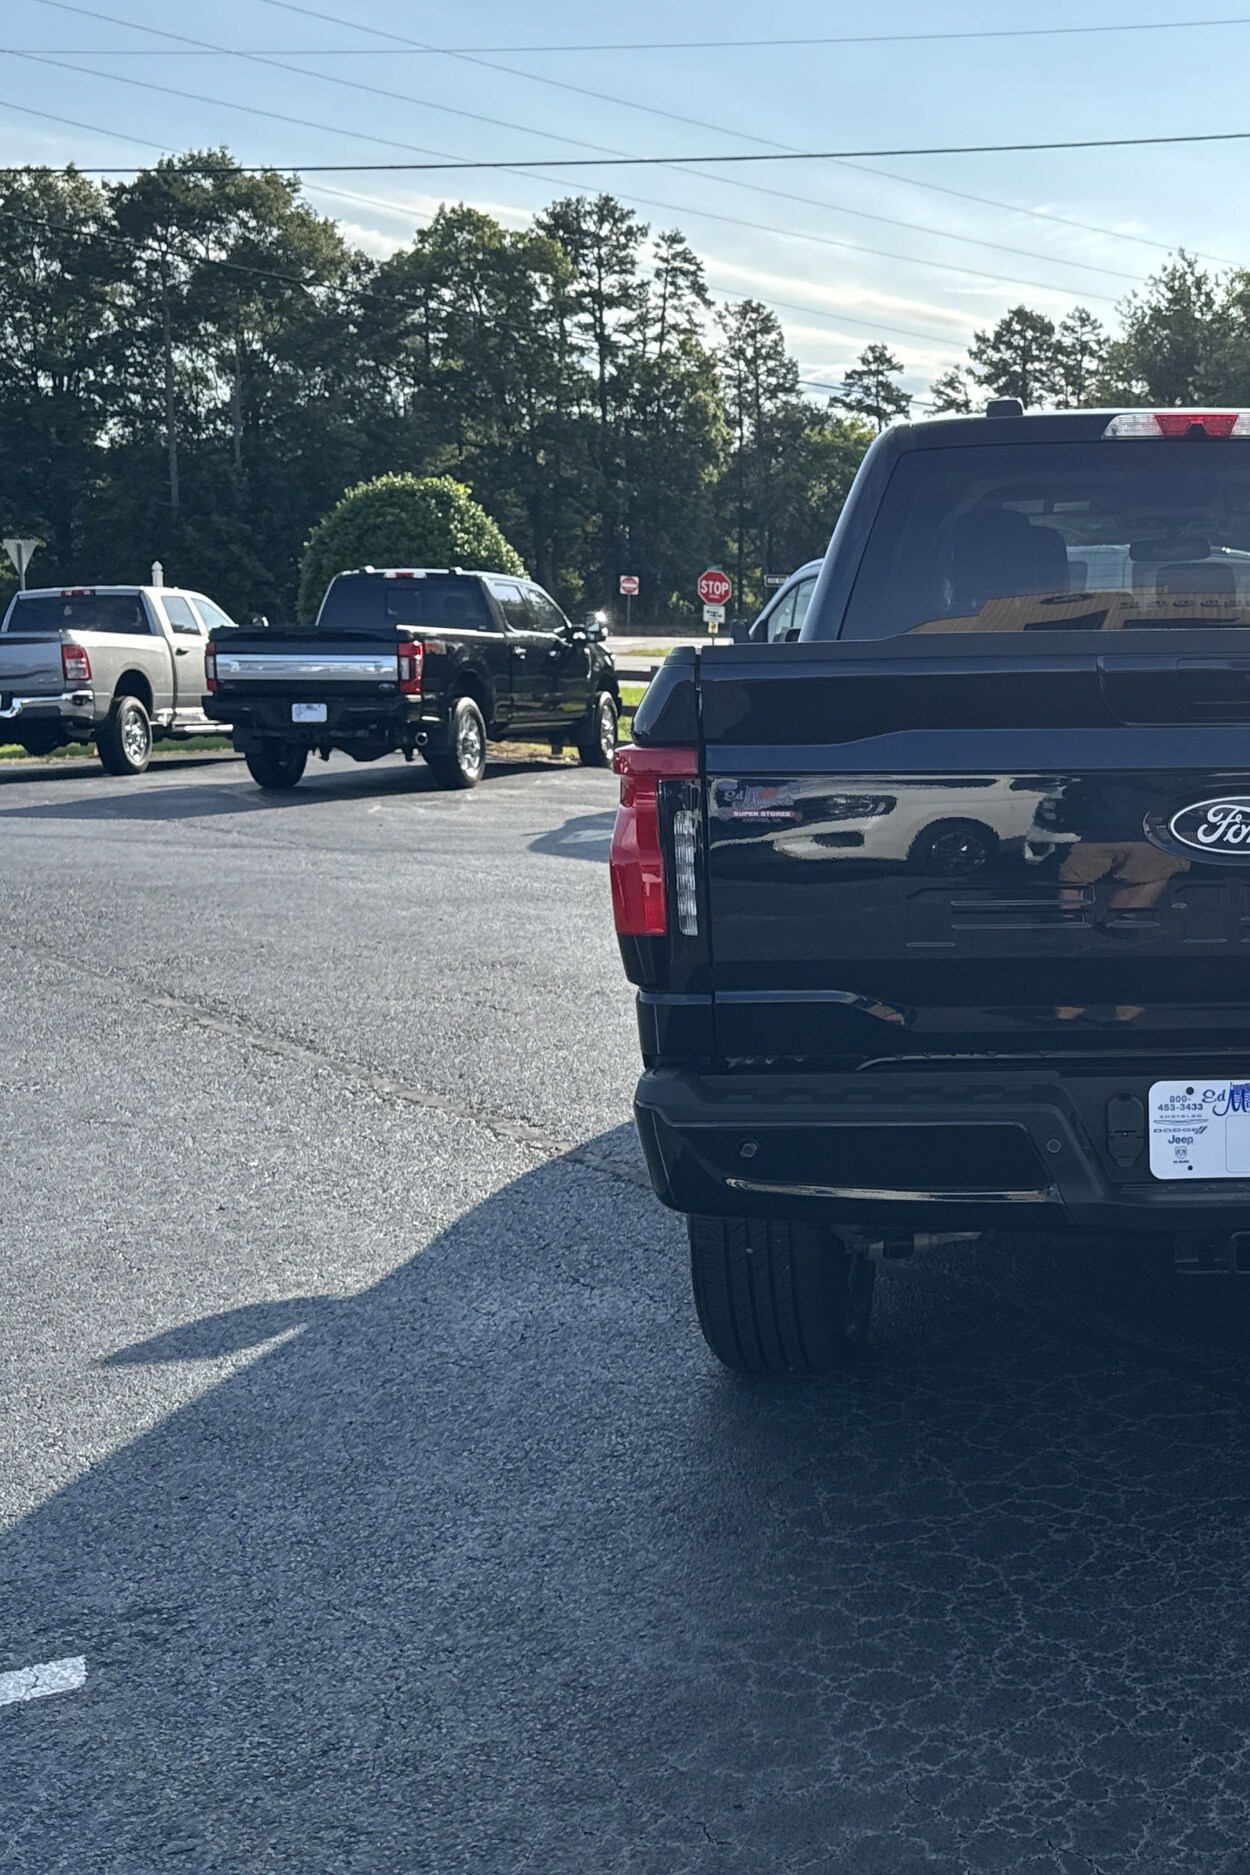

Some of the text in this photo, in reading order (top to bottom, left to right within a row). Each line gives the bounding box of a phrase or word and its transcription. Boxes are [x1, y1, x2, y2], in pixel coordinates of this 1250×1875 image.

[701, 580, 729, 595] STOP
[1169, 1095, 1192, 1103] 800-
[1201, 1088, 1226, 1103] Ed
[1158, 1103, 1203, 1111] 453-3433
[1168, 1134, 1194, 1145] Jeep
